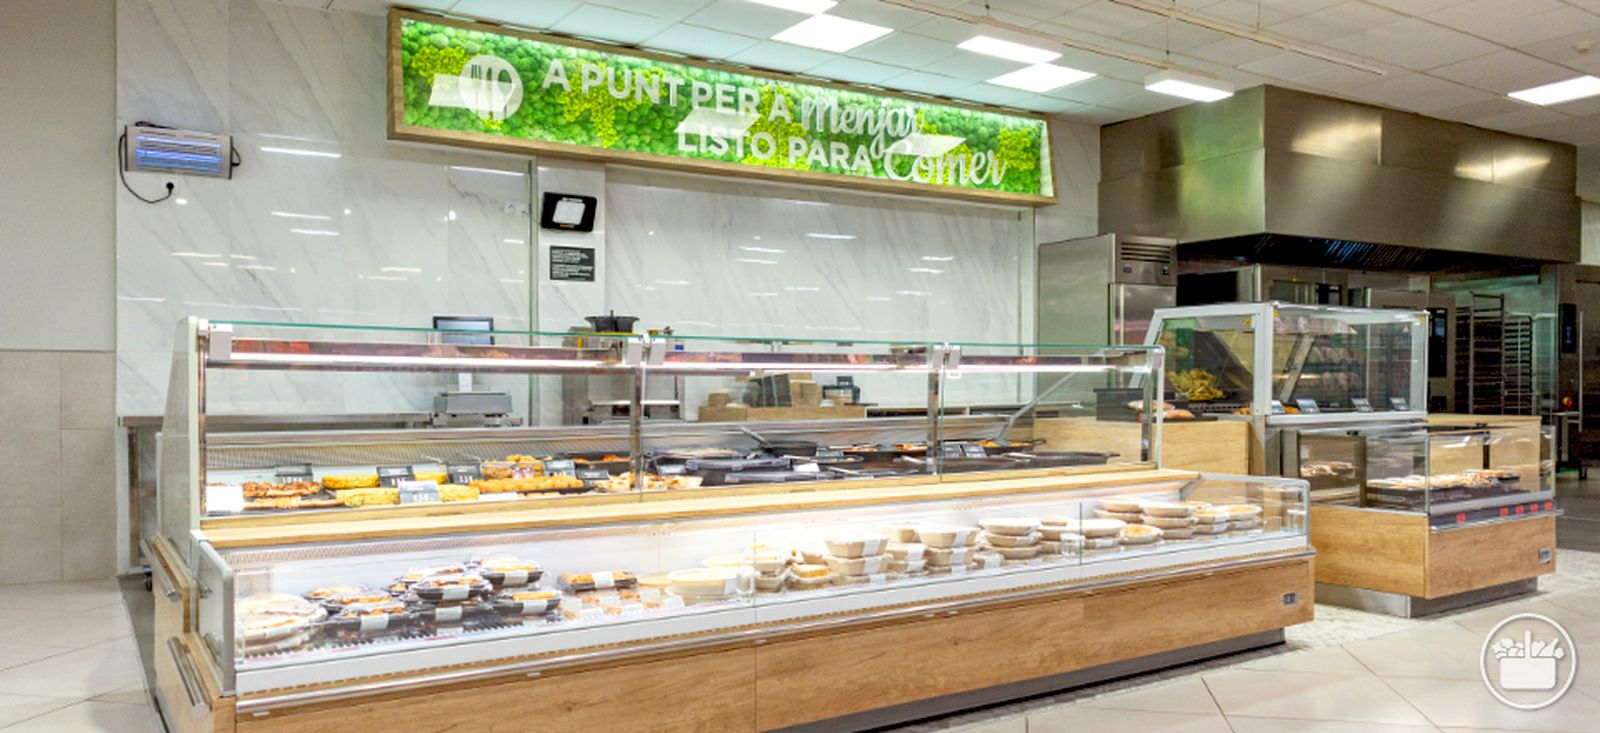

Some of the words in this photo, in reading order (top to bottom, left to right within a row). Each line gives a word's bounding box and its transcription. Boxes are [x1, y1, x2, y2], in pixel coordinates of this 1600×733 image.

[542, 58, 571, 92] A
[581, 63, 684, 107] PUNT
[692, 80, 760, 116] PER
[768, 95, 792, 124] A
[678, 121, 776, 160] LISTO
[788, 137, 874, 177] PARA
[883, 139, 1008, 185] Comer
